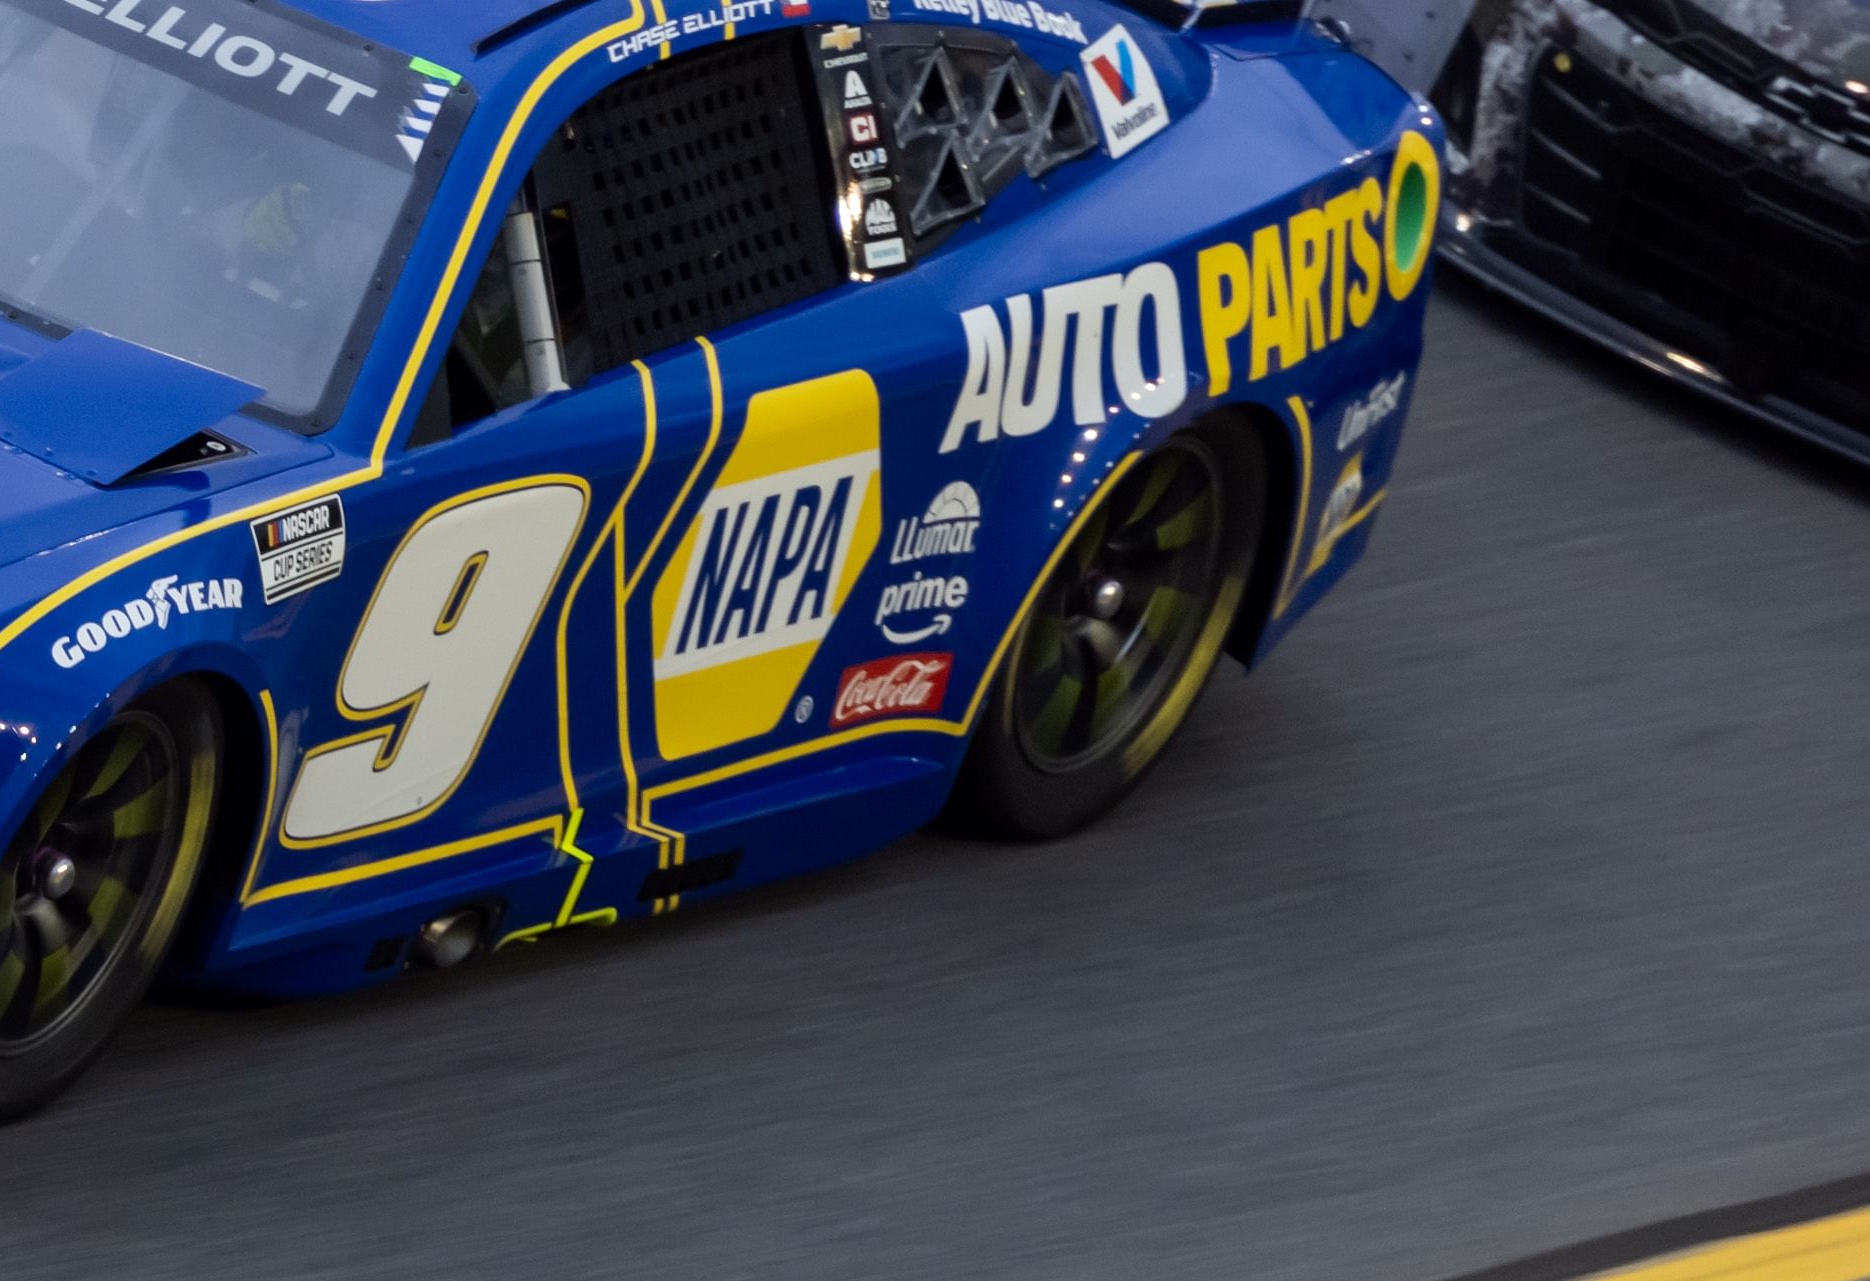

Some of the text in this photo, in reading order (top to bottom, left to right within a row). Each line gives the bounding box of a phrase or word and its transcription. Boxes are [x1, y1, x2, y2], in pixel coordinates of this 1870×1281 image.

[607, 19, 680, 63] CHASE
[1027, 0, 1089, 45] Book
[939, 175, 1386, 455] AUTO PARTS
[282, 505, 331, 542] NASCAR
[273, 540, 333, 581] CUP SERIES
[676, 474, 856, 657] NAPA
[874, 571, 968, 626] prime
[279, 472, 591, 850] 9
